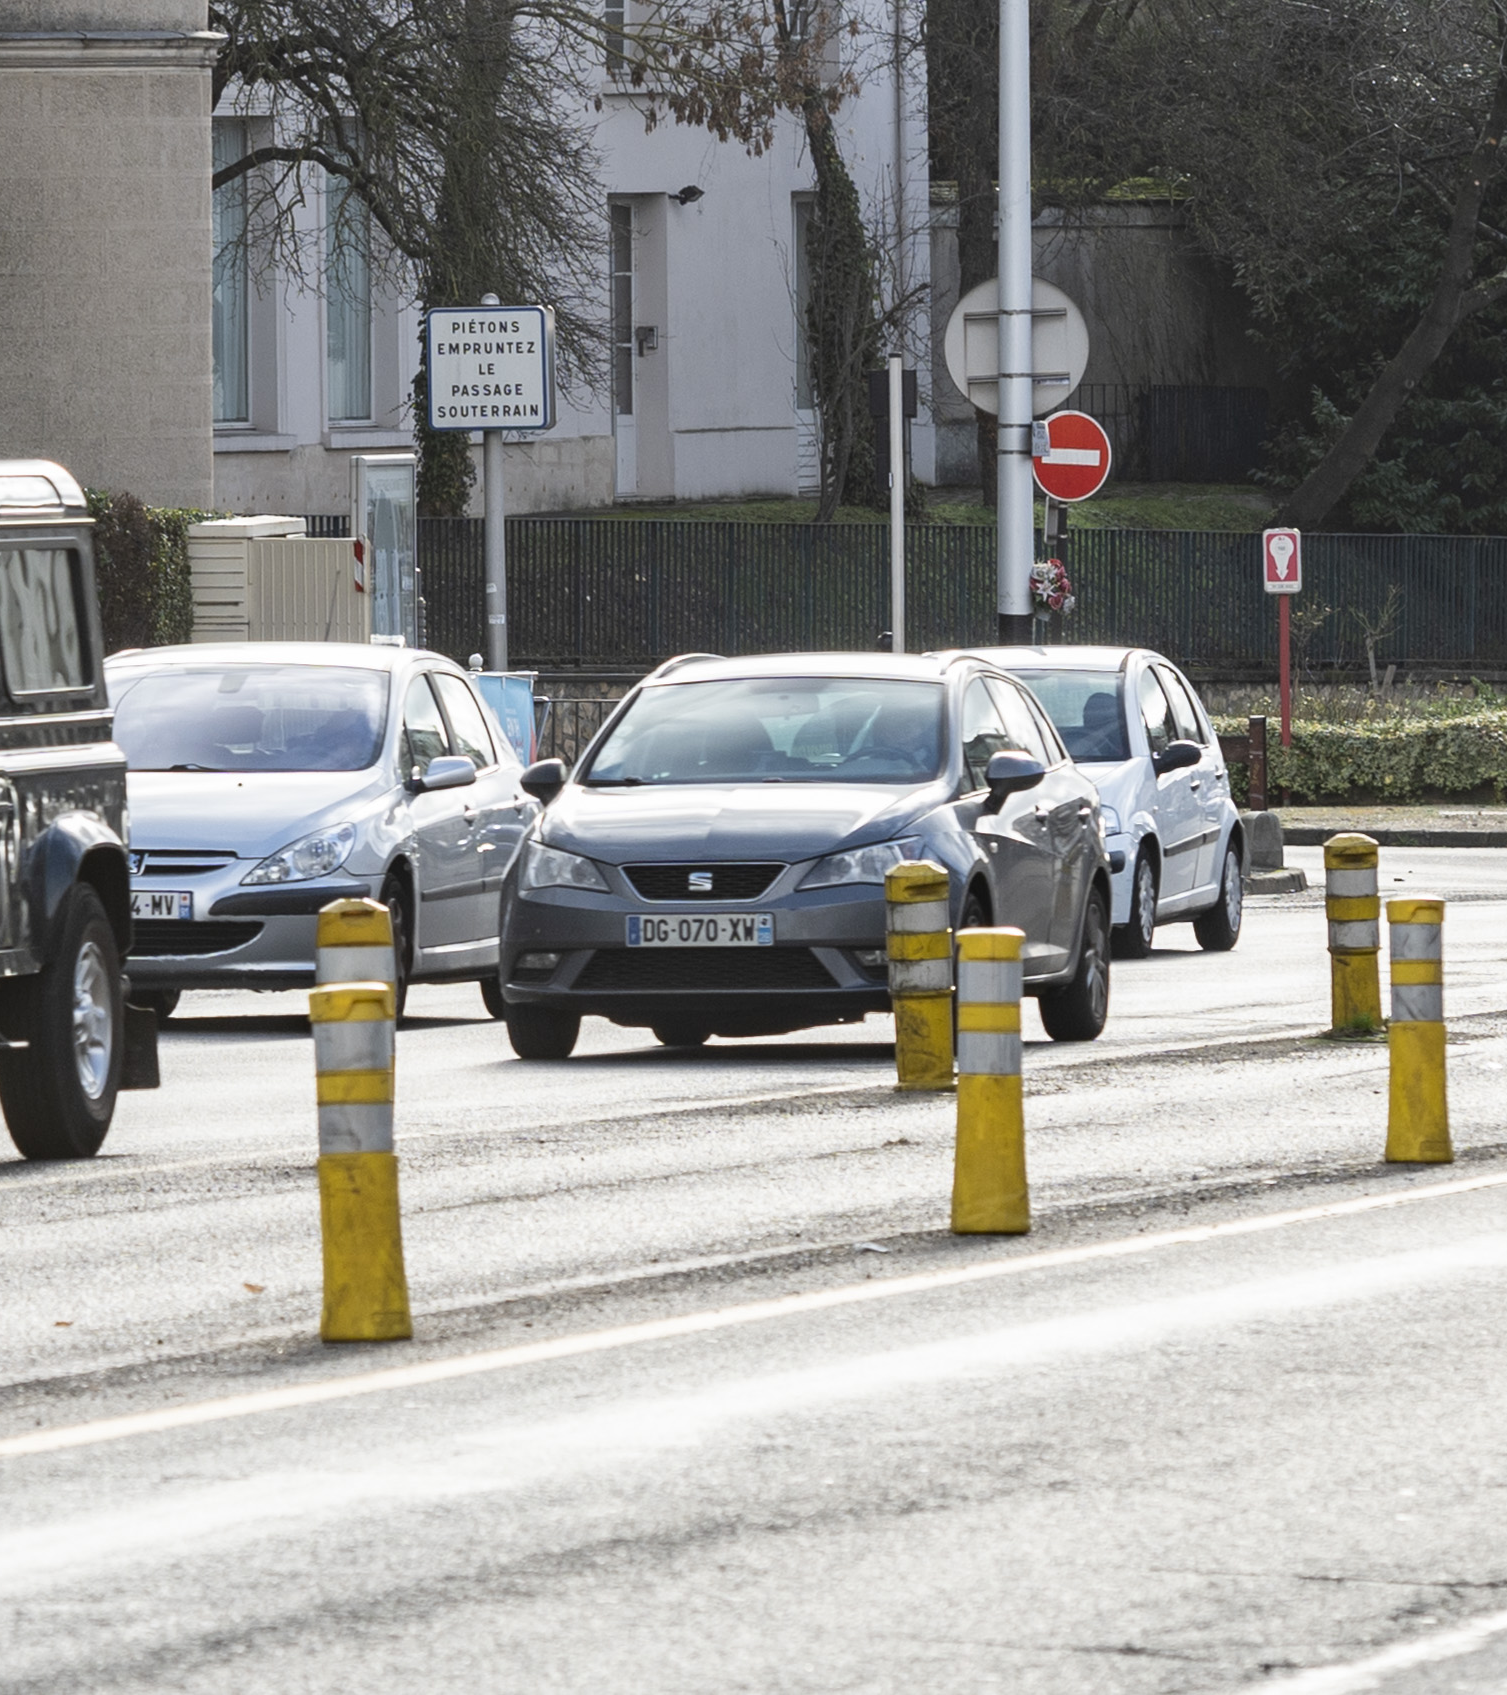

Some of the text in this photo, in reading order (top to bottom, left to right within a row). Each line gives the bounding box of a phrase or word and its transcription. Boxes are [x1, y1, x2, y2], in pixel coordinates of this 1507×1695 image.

[452, 319, 520, 334] PIÉTONS
[437, 341, 535, 355] EMPRUNTEZ
[478, 363, 495, 375] LE
[451, 383, 523, 396] PASSAGE
[437, 405, 539, 418] SOUTERRAIN
[643, 918, 755, 943] DG-070-XW
